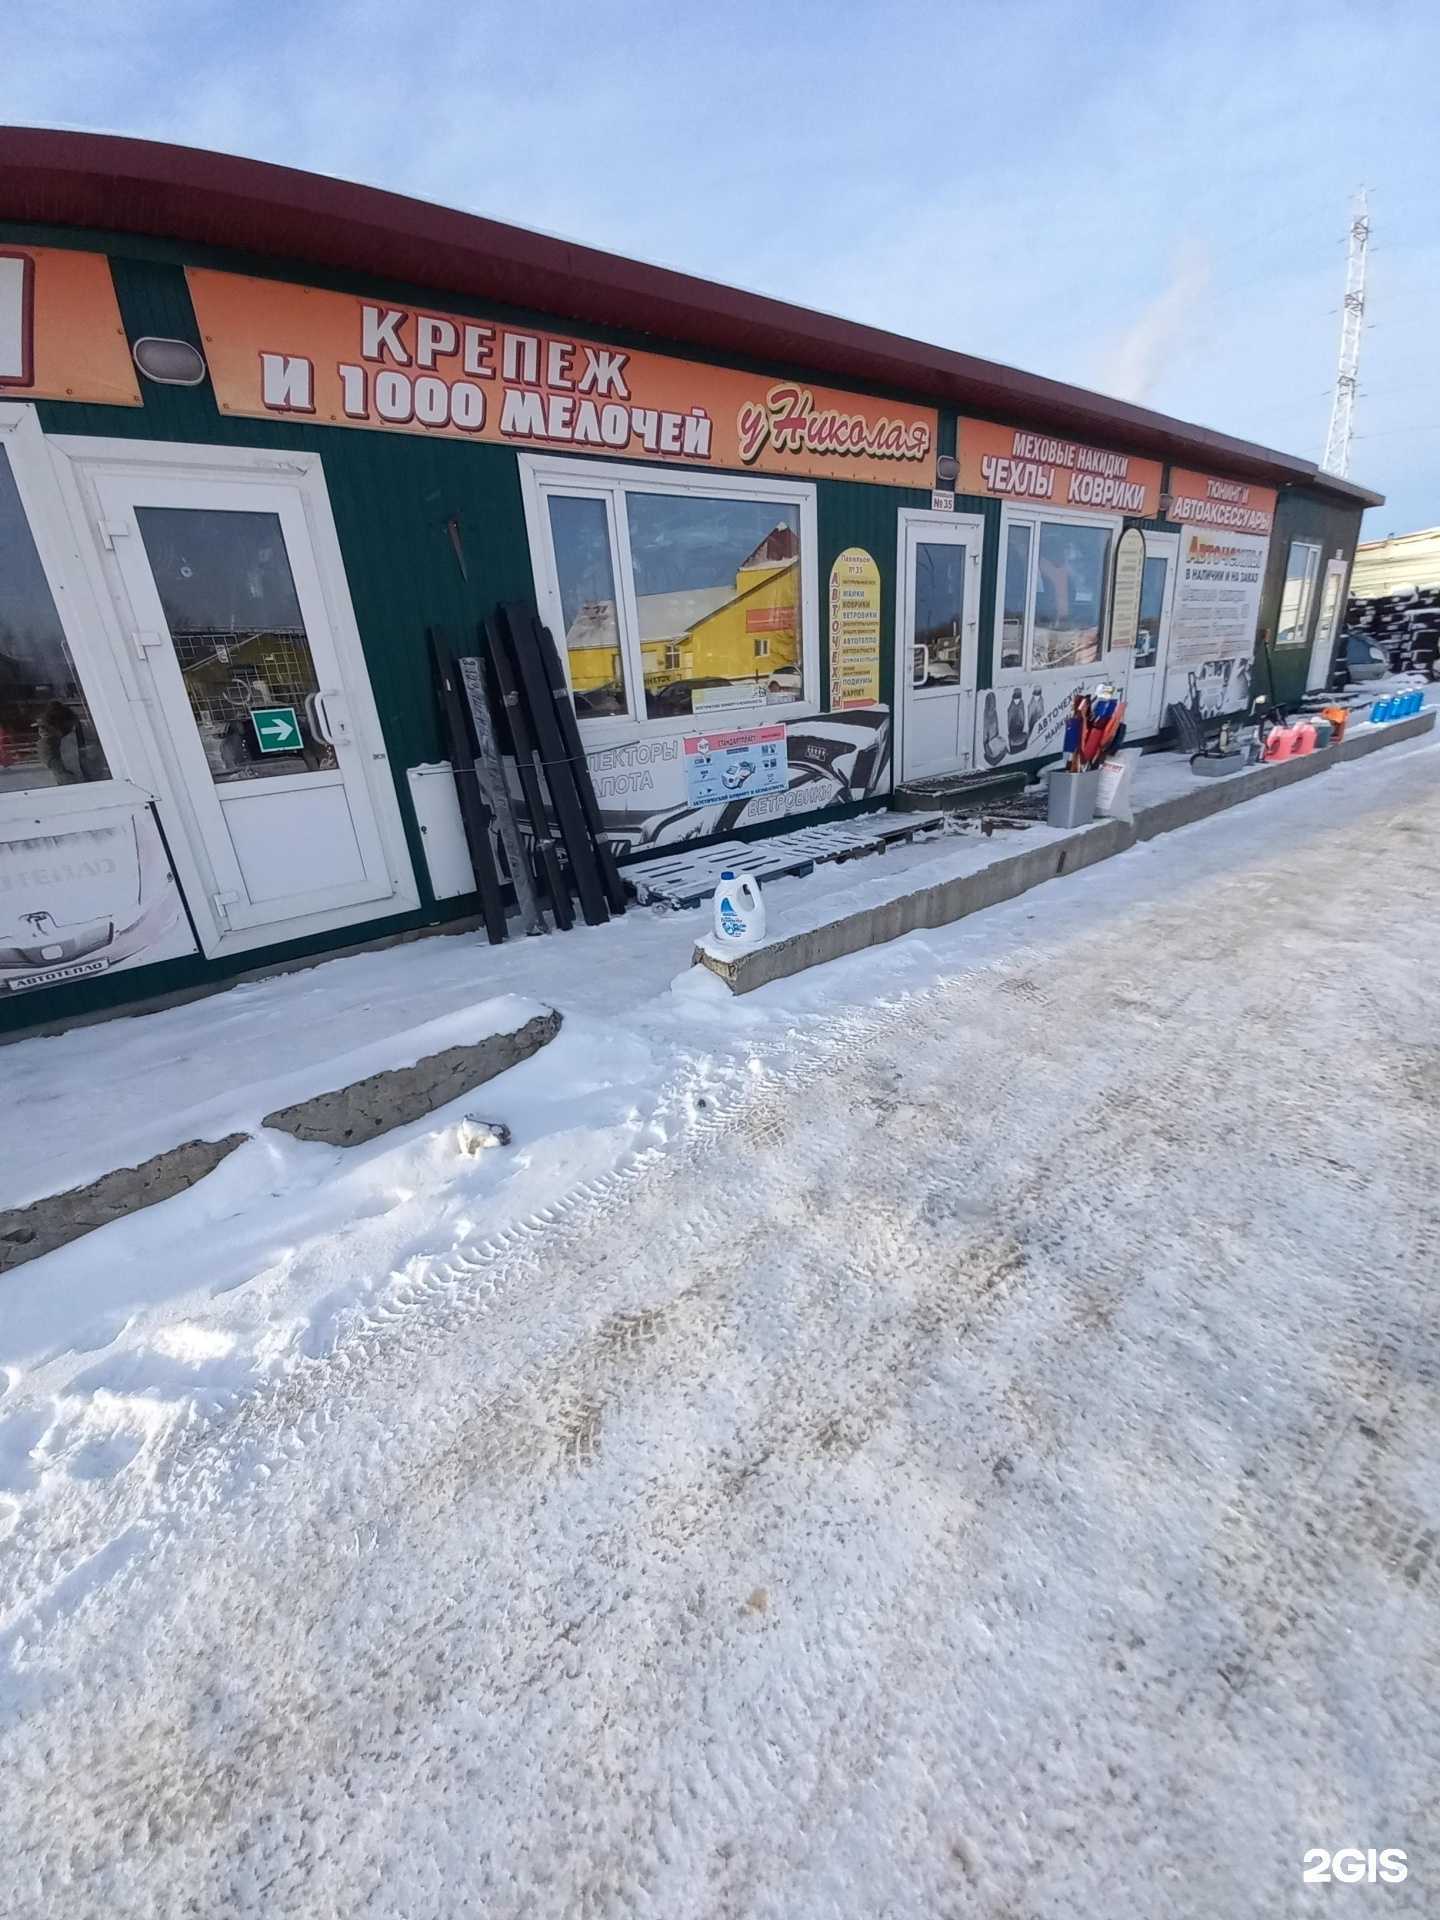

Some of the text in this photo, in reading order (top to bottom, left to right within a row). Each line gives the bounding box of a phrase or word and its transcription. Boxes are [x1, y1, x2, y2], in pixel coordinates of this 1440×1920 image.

[360, 304, 630, 399] КРЕПЕЖ
[261, 353, 712, 459] И 1000 МЕЛОЧЕЙ
[1012, 432, 1129, 478] МЕХОВЫЕ НАКИДКИ
[982, 455, 1146, 512] ЧЕХЛЫ КОВРИКИ
[1207, 480, 1249, 504] ТЮНИНГ И
[1173, 497, 1270, 531] АВТОАКСЕССУАРЫ
[832, 572, 841, 708] АВТОЧЕХЛЫ
[587, 740, 678, 772] ЛЕКТОРЫ
[593, 771, 653, 799] АПОТА
[748, 784, 832, 817] ВЕТРОВИКИ
[16, 962, 103, 988] АВТОТЕПЛО
